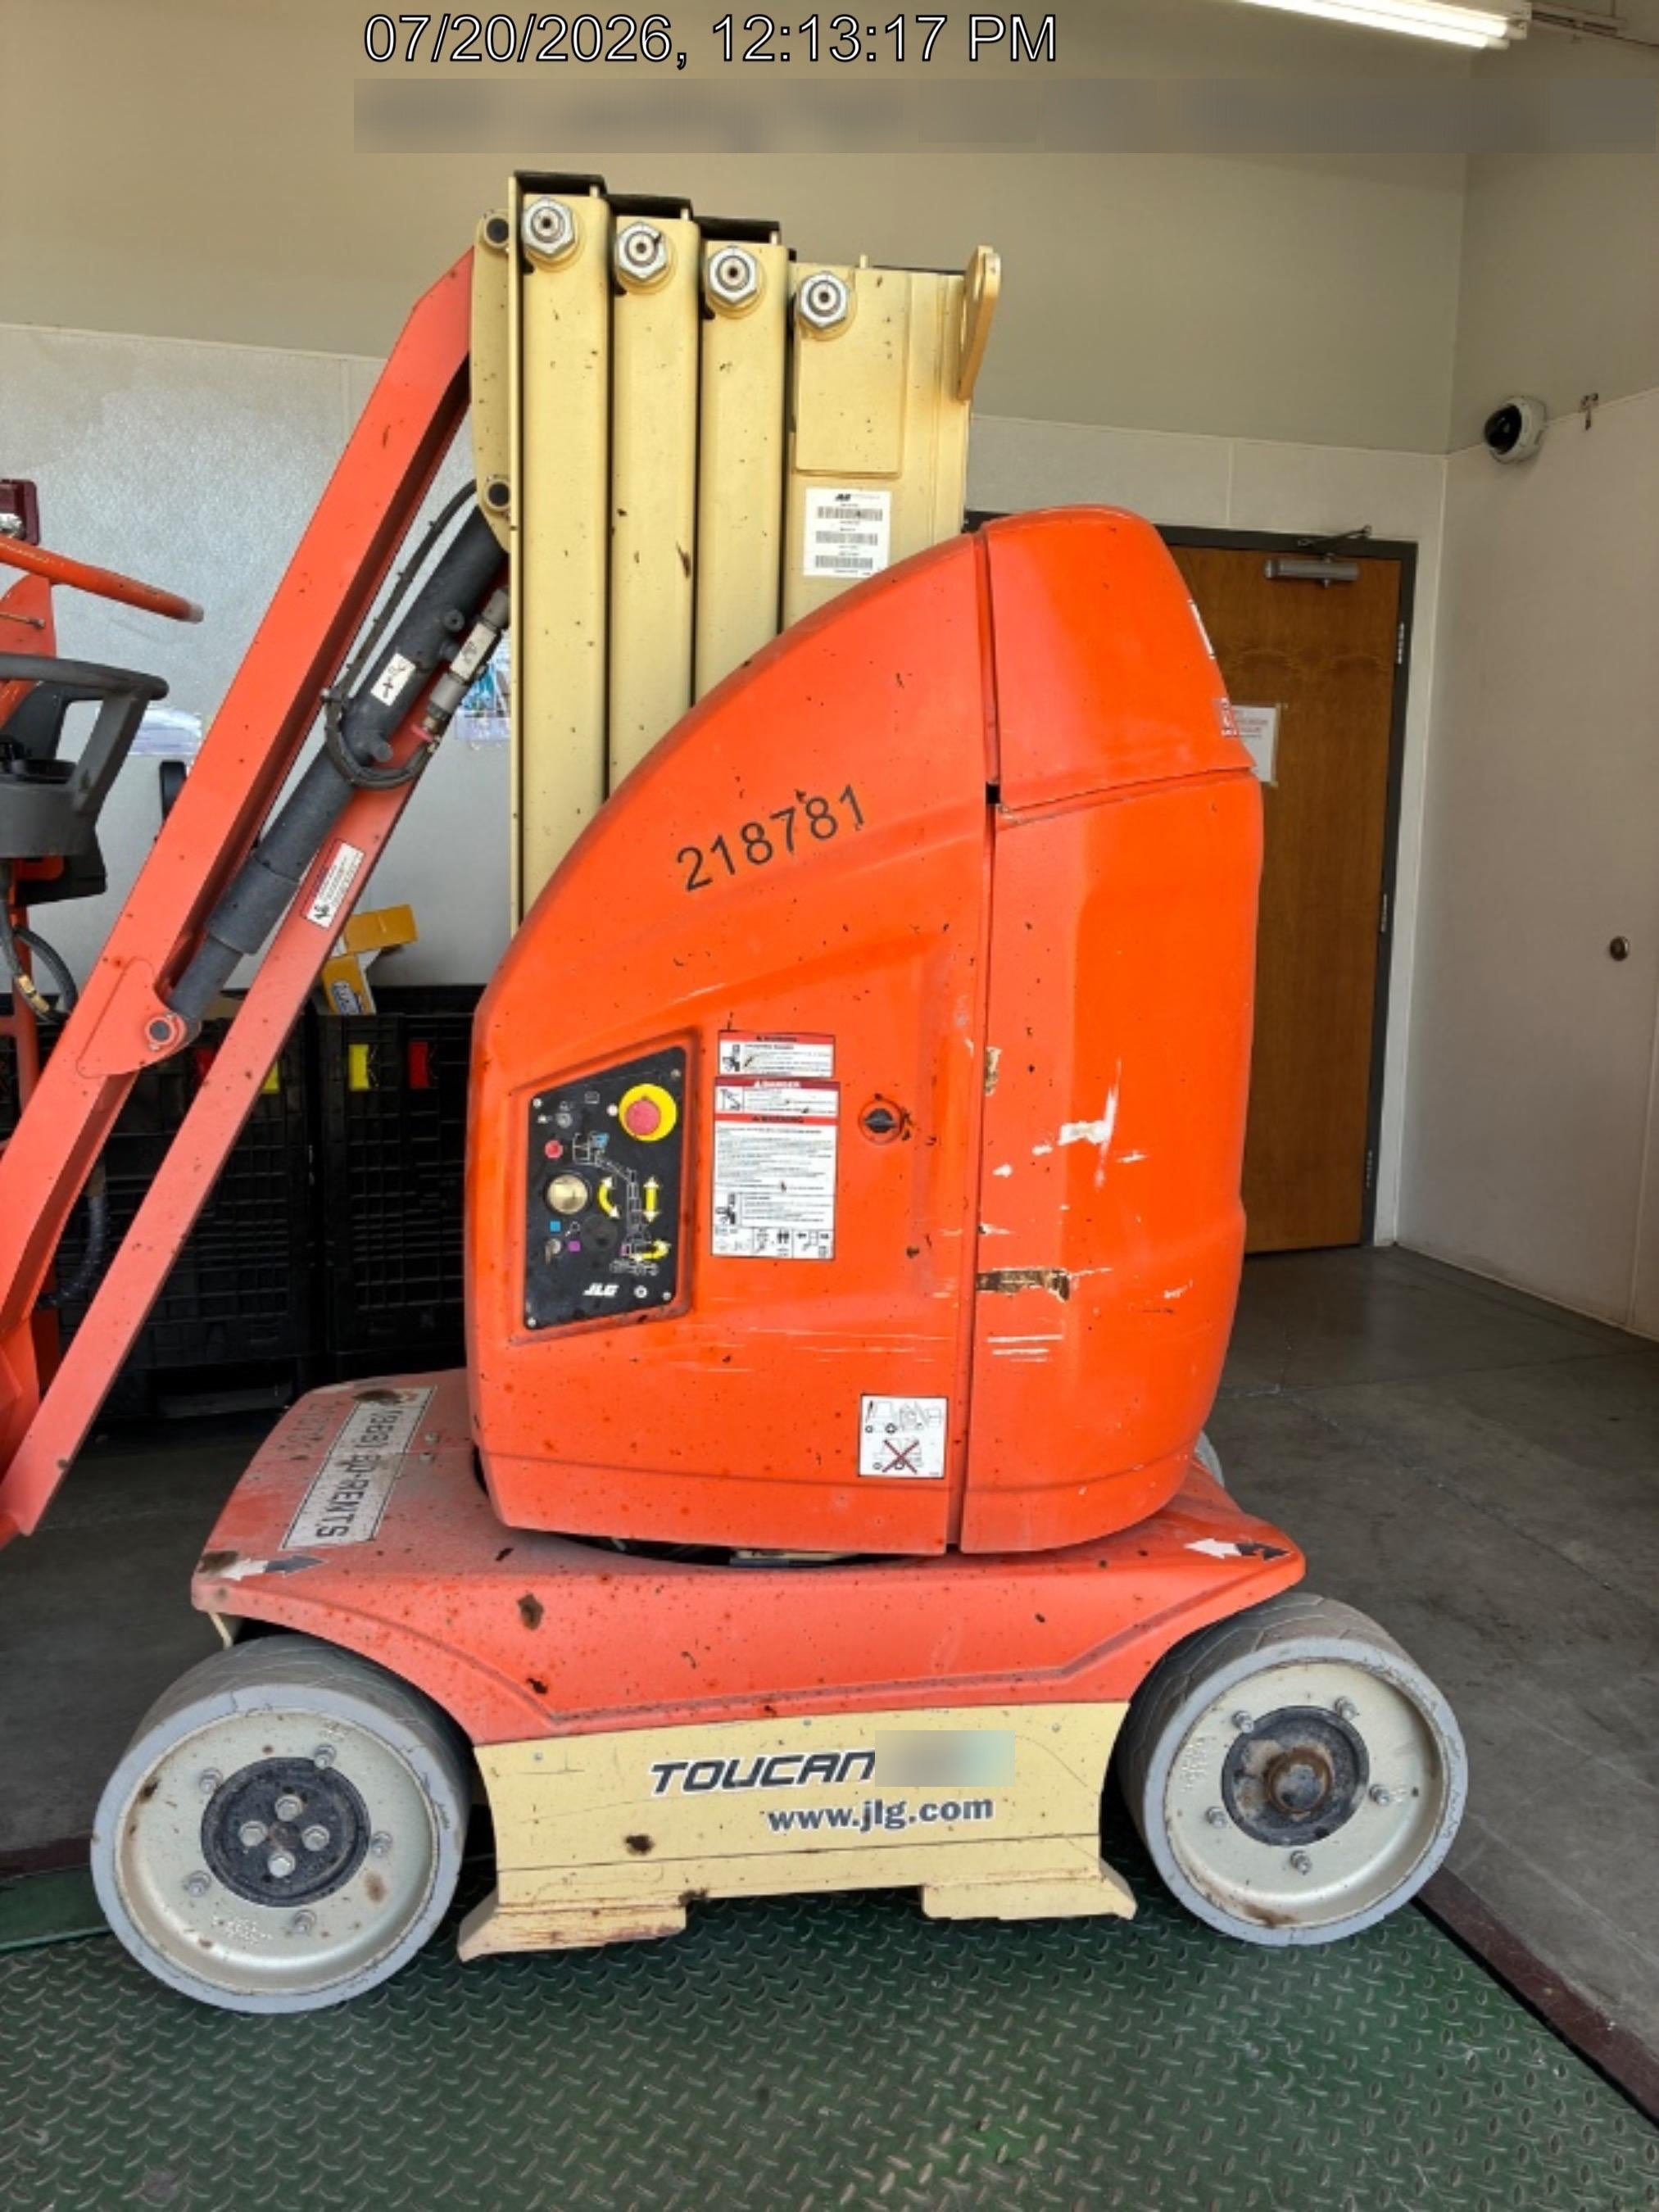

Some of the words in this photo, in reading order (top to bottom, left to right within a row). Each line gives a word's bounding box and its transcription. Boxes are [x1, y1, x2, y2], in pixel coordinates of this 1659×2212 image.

[677, 784, 865, 892] 218781
[582, 1282, 619, 1298] JLG
[649, 1749, 876, 1795] TOUCAN
[768, 1797, 994, 1832] www.jlg.com
